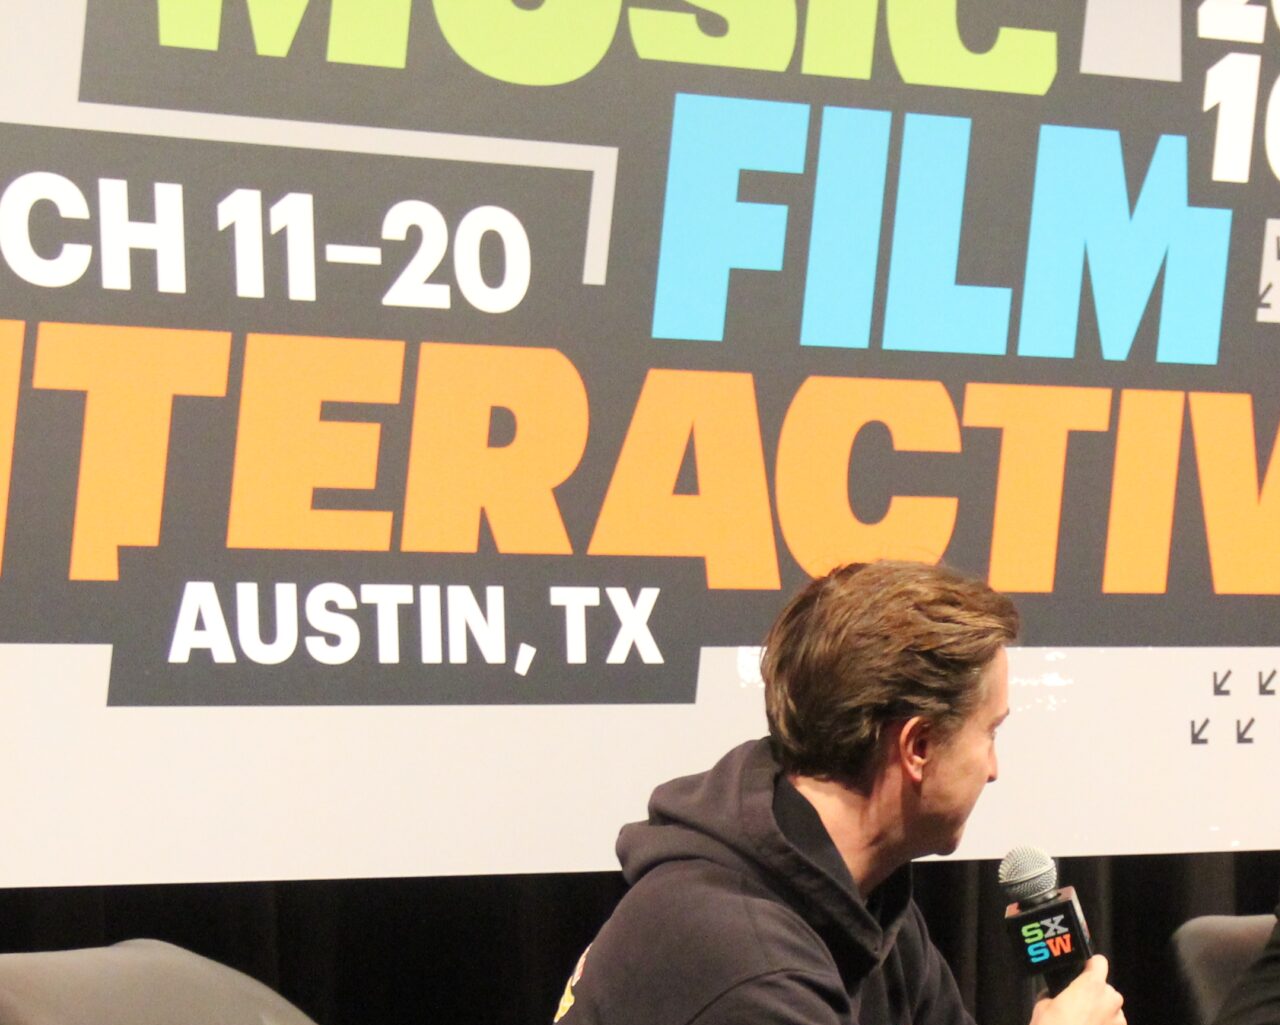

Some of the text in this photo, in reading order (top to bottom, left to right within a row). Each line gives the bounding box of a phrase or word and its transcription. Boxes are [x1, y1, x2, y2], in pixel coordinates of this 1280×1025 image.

[0, 171, 187, 294] CH
[652, 93, 1232, 365] FILM
[168, 582, 665, 677] AUSTIN, TX
